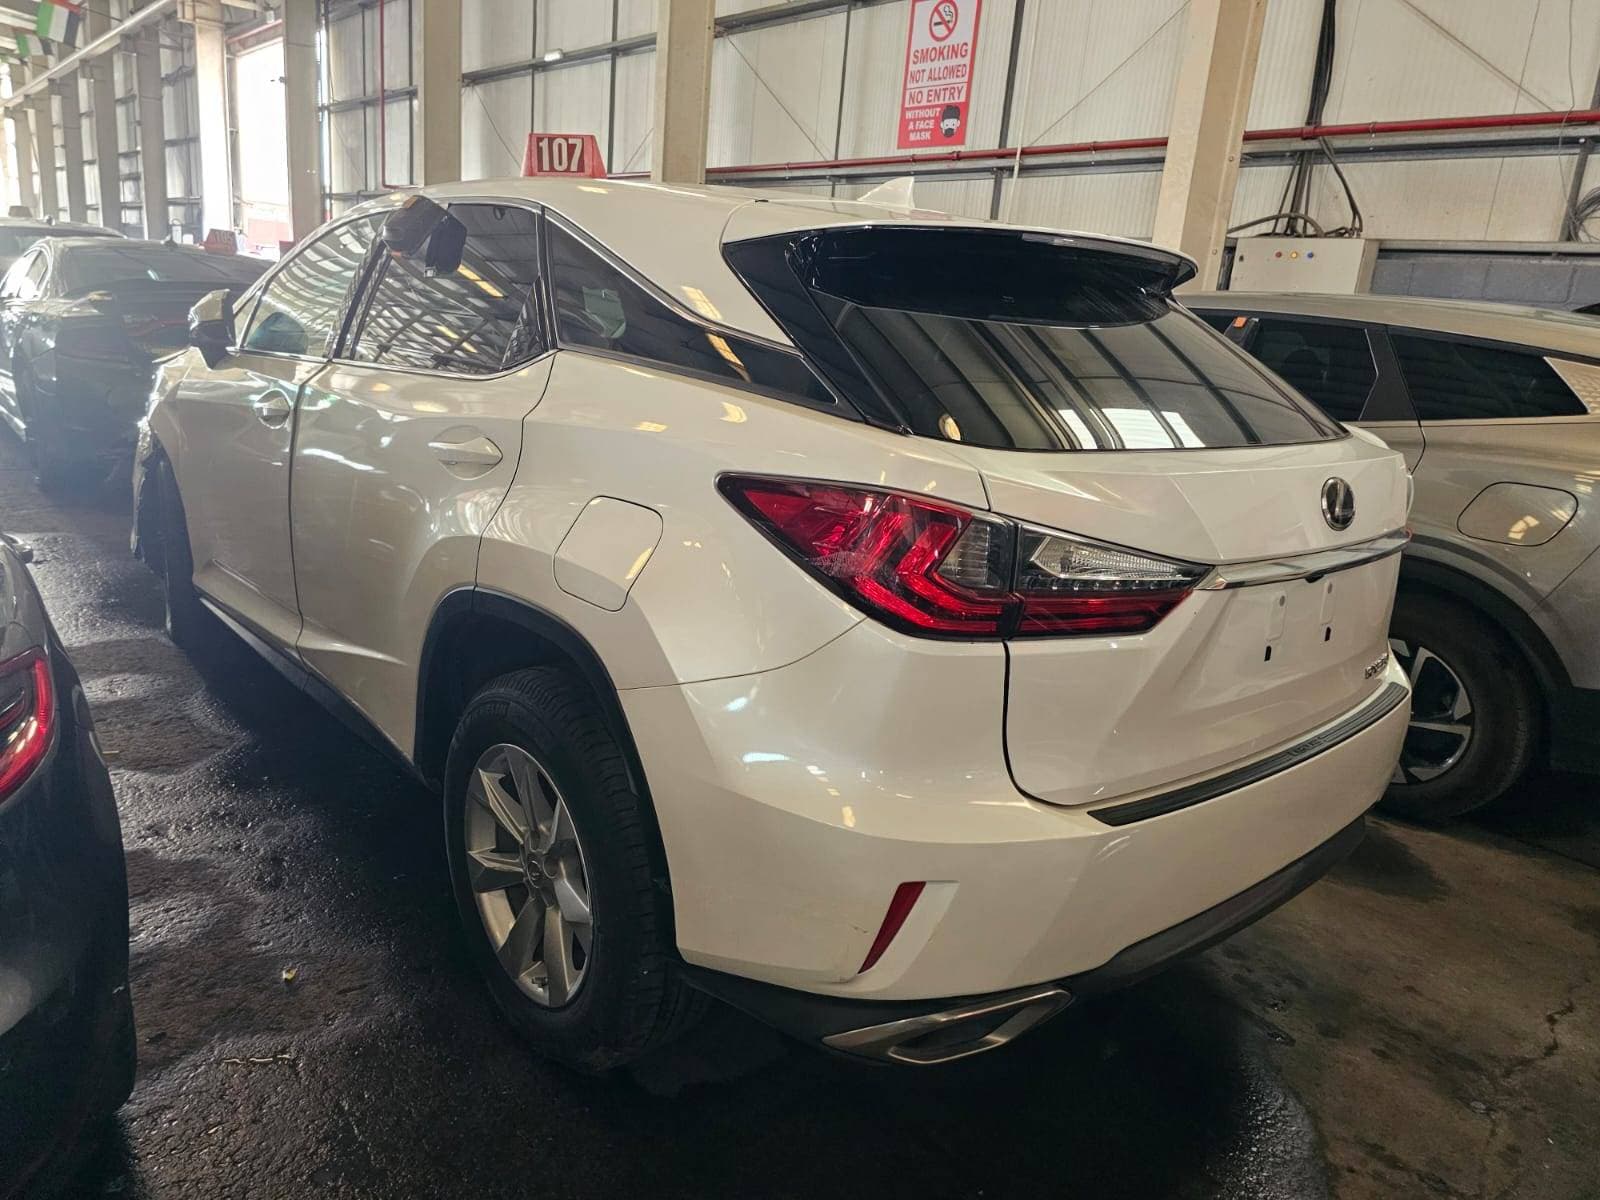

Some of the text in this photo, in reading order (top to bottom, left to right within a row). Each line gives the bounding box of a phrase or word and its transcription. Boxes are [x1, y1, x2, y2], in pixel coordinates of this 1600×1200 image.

[912, 42, 968, 65] SMOKING
[909, 64, 967, 84] NOT ALLOWED
[909, 86, 964, 105] NO ENTRY
[906, 108, 941, 119] WITHOUT
[908, 119, 935, 130] A FACE
[909, 131, 931, 141] MASK
[538, 137, 583, 172] 107
